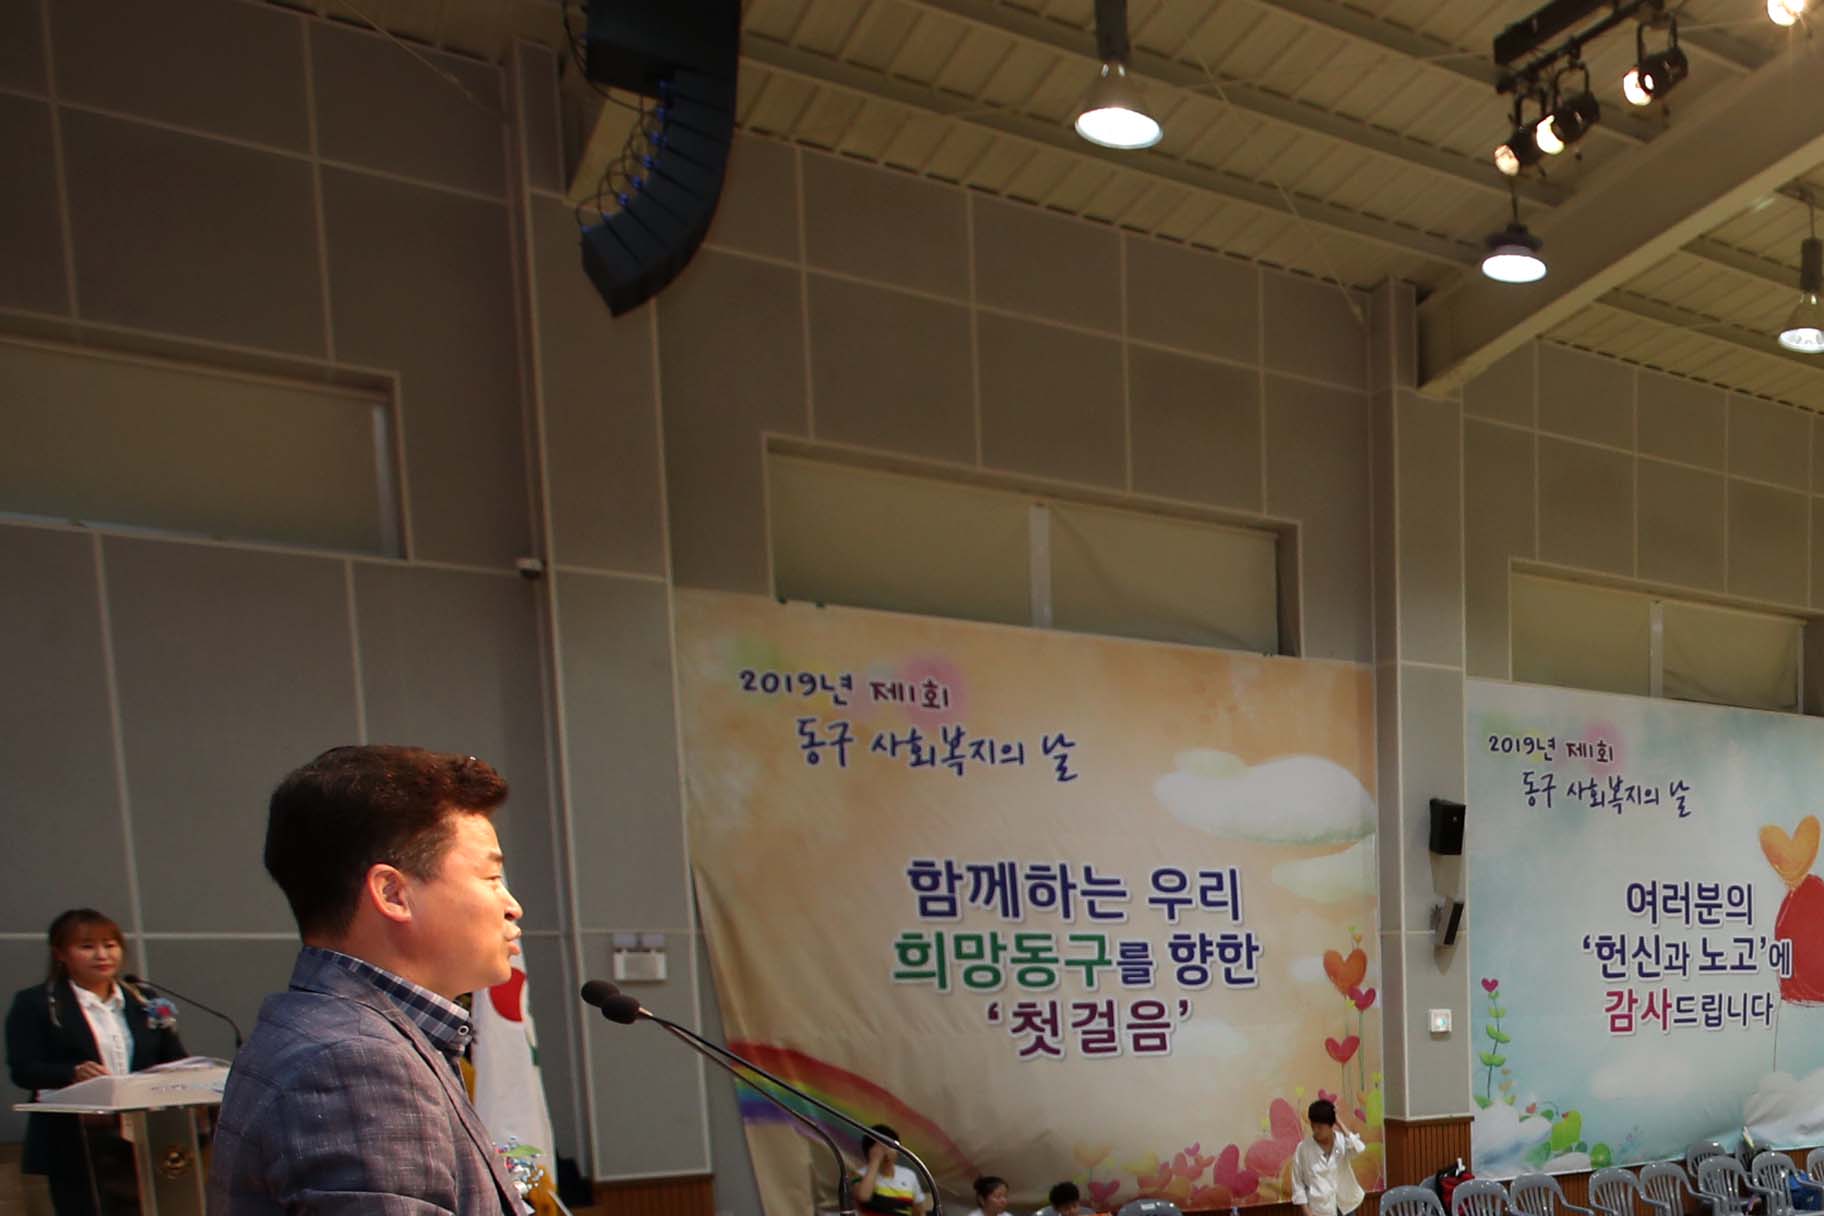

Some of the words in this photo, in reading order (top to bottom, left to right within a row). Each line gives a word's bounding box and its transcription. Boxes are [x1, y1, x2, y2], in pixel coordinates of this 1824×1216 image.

[739, 670, 853, 706] 2019년
[869, 680, 950, 709] 제1회
[796, 717, 854, 767] 동구
[870, 725, 1025, 776] 사회복지의
[1042, 733, 1079, 782] 날
[1488, 735, 1556, 762] 2019년
[1566, 739, 1614, 763] 제1회
[1522, 770, 1557, 808] 동구
[1566, 775, 1659, 814] 사회복지의
[1669, 780, 1691, 818] 날
[906, 859, 1129, 919] 함께하는
[1147, 866, 1241, 921] 우리
[1626, 880, 1753, 926] 여러분의
[893, 930, 1154, 990] 희망동구를
[1166, 932, 1260, 987] 향한
[1604, 987, 1774, 1033] 감사드립니다
